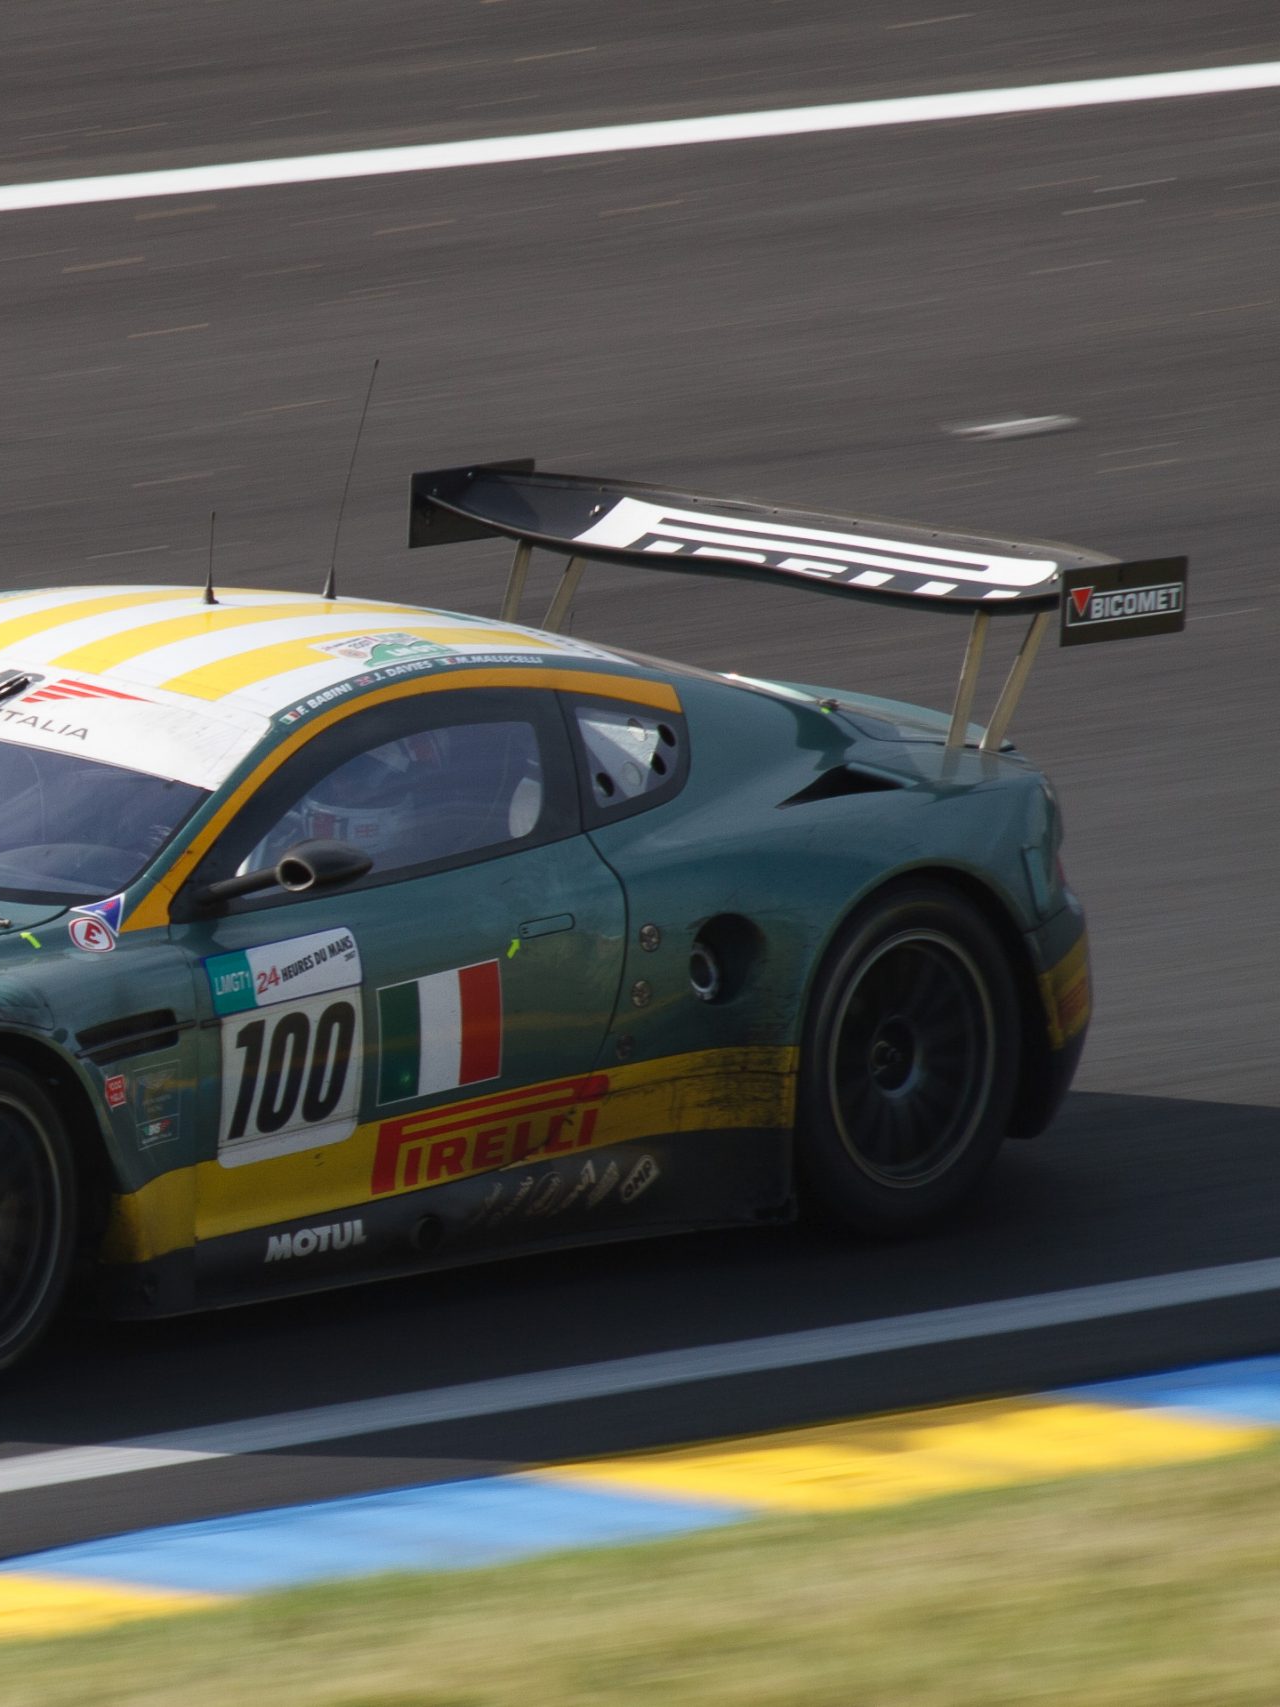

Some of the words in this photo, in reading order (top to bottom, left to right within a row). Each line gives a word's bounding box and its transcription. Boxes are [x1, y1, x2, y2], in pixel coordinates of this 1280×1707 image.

[1090, 587, 1181, 619] BICOMET
[386, 659, 434, 678] DAVIES
[307, 682, 353, 710] BABINI
[214, 970, 252, 996] LMGT1
[256, 965, 281, 994] 24
[281, 954, 315, 982] HEURES
[315, 948, 328, 966] DU
[327, 935, 354, 959] MANS
[227, 1001, 356, 1140] 100
[371, 1074, 609, 1196] PIRELLI
[264, 1219, 368, 1263] MOTUL
